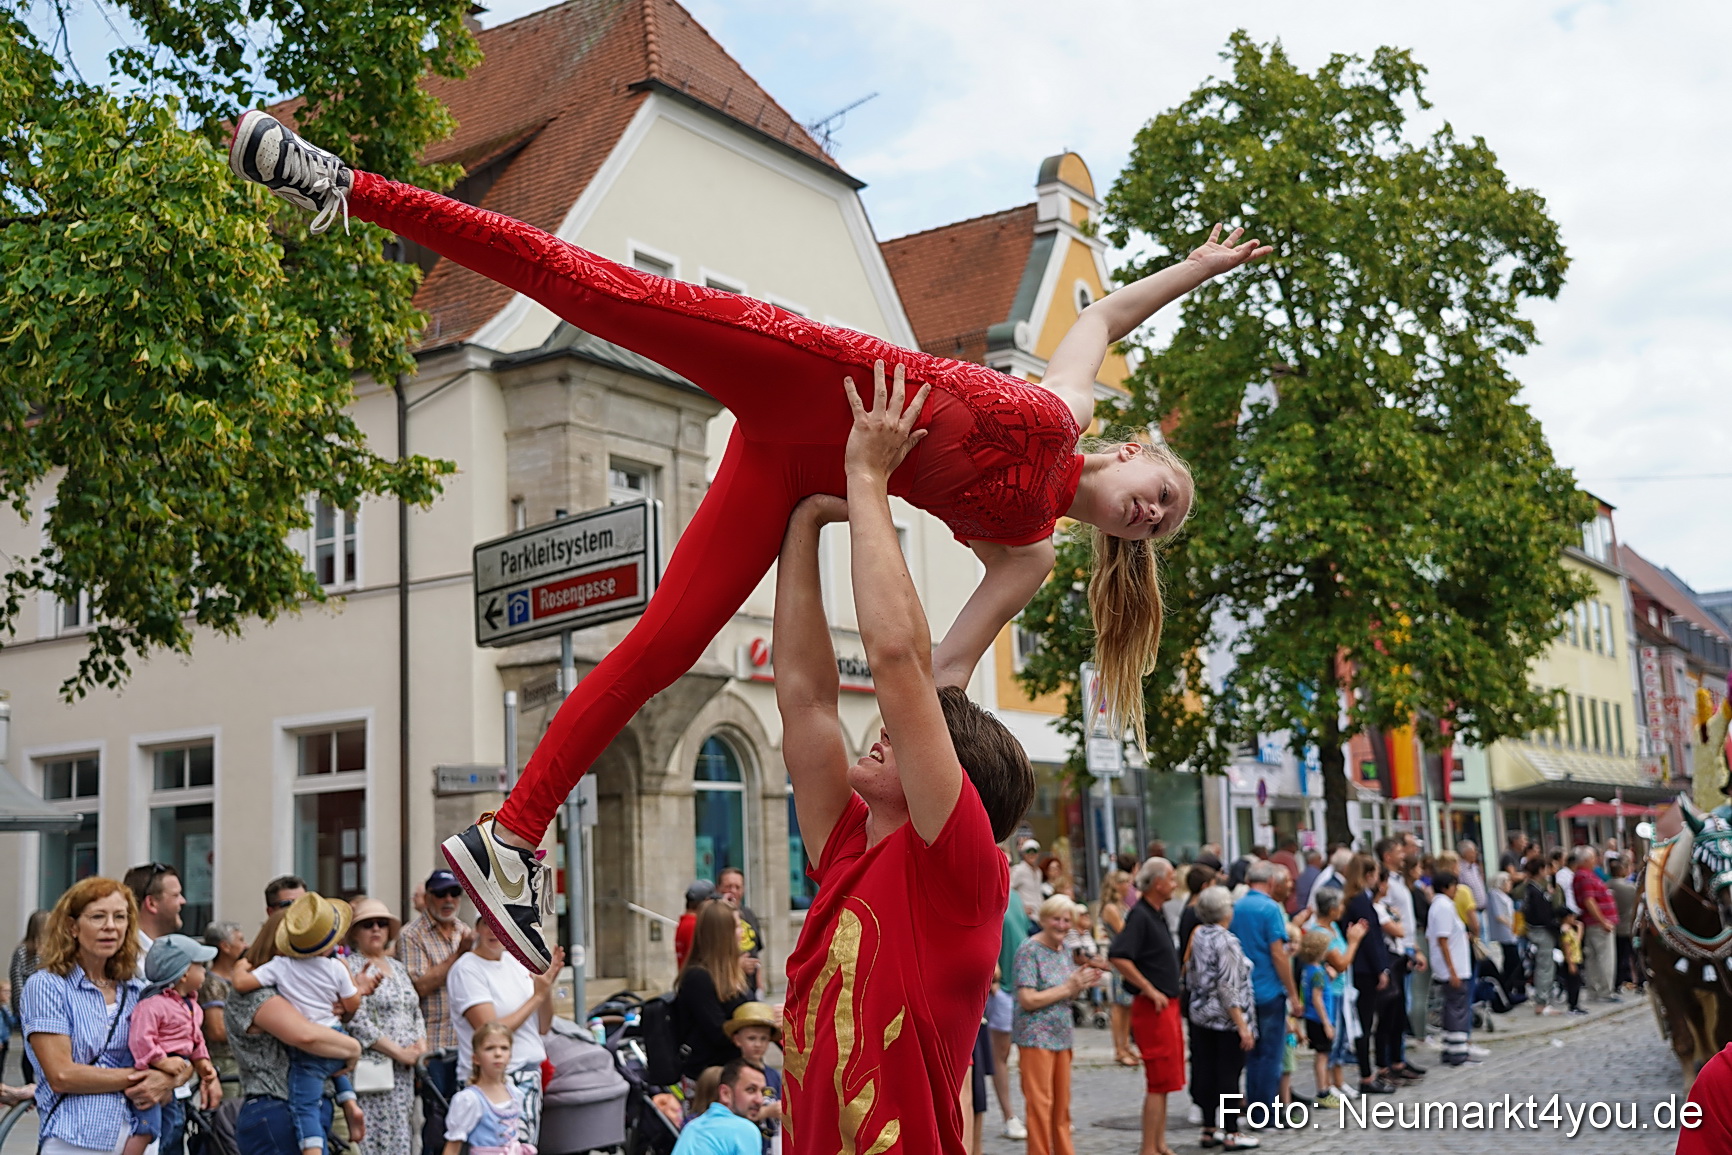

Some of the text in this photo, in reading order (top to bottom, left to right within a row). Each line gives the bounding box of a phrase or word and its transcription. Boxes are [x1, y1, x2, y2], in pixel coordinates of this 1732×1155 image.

[501, 528, 614, 576] Parkleitsystem
[514, 577, 616, 623] P Rosengasse
